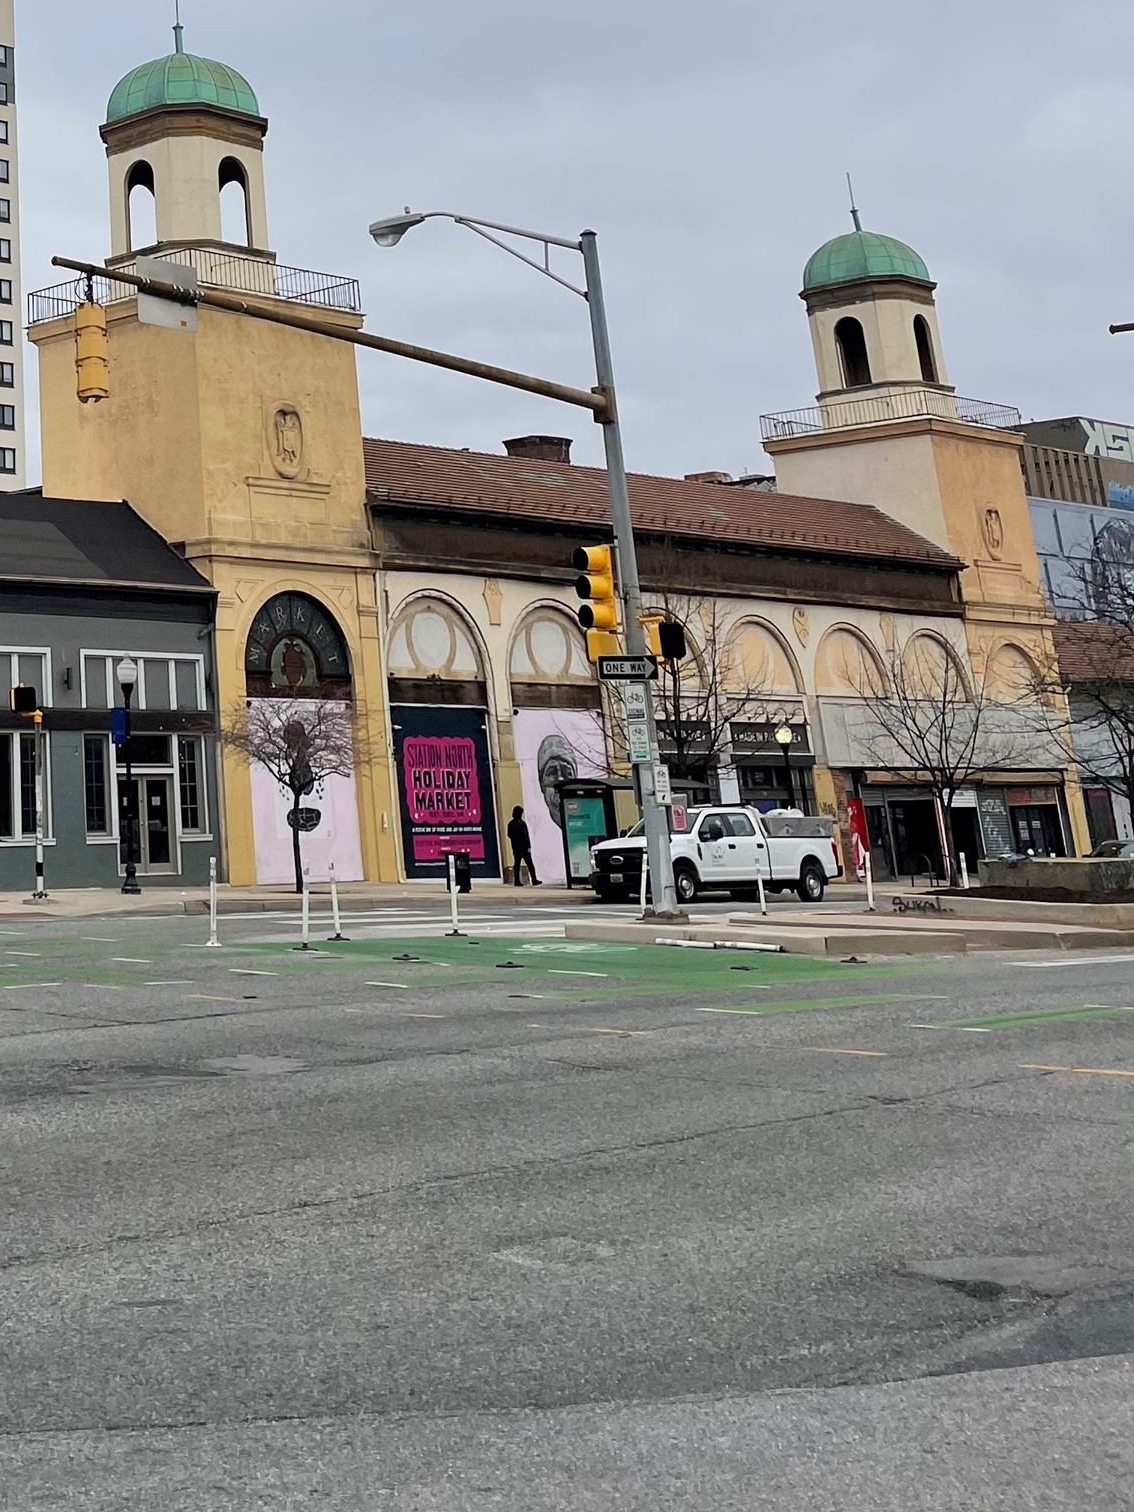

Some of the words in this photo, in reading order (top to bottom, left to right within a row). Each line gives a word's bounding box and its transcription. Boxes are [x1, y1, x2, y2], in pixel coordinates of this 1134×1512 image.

[605, 662, 626, 673] ONE
[630, 662, 647, 673] WAY
[407, 743, 442, 768] STATION
[444, 744, 473, 768] NORTH
[412, 768, 471, 789] HOLIDAY
[414, 790, 471, 810] MARKET
